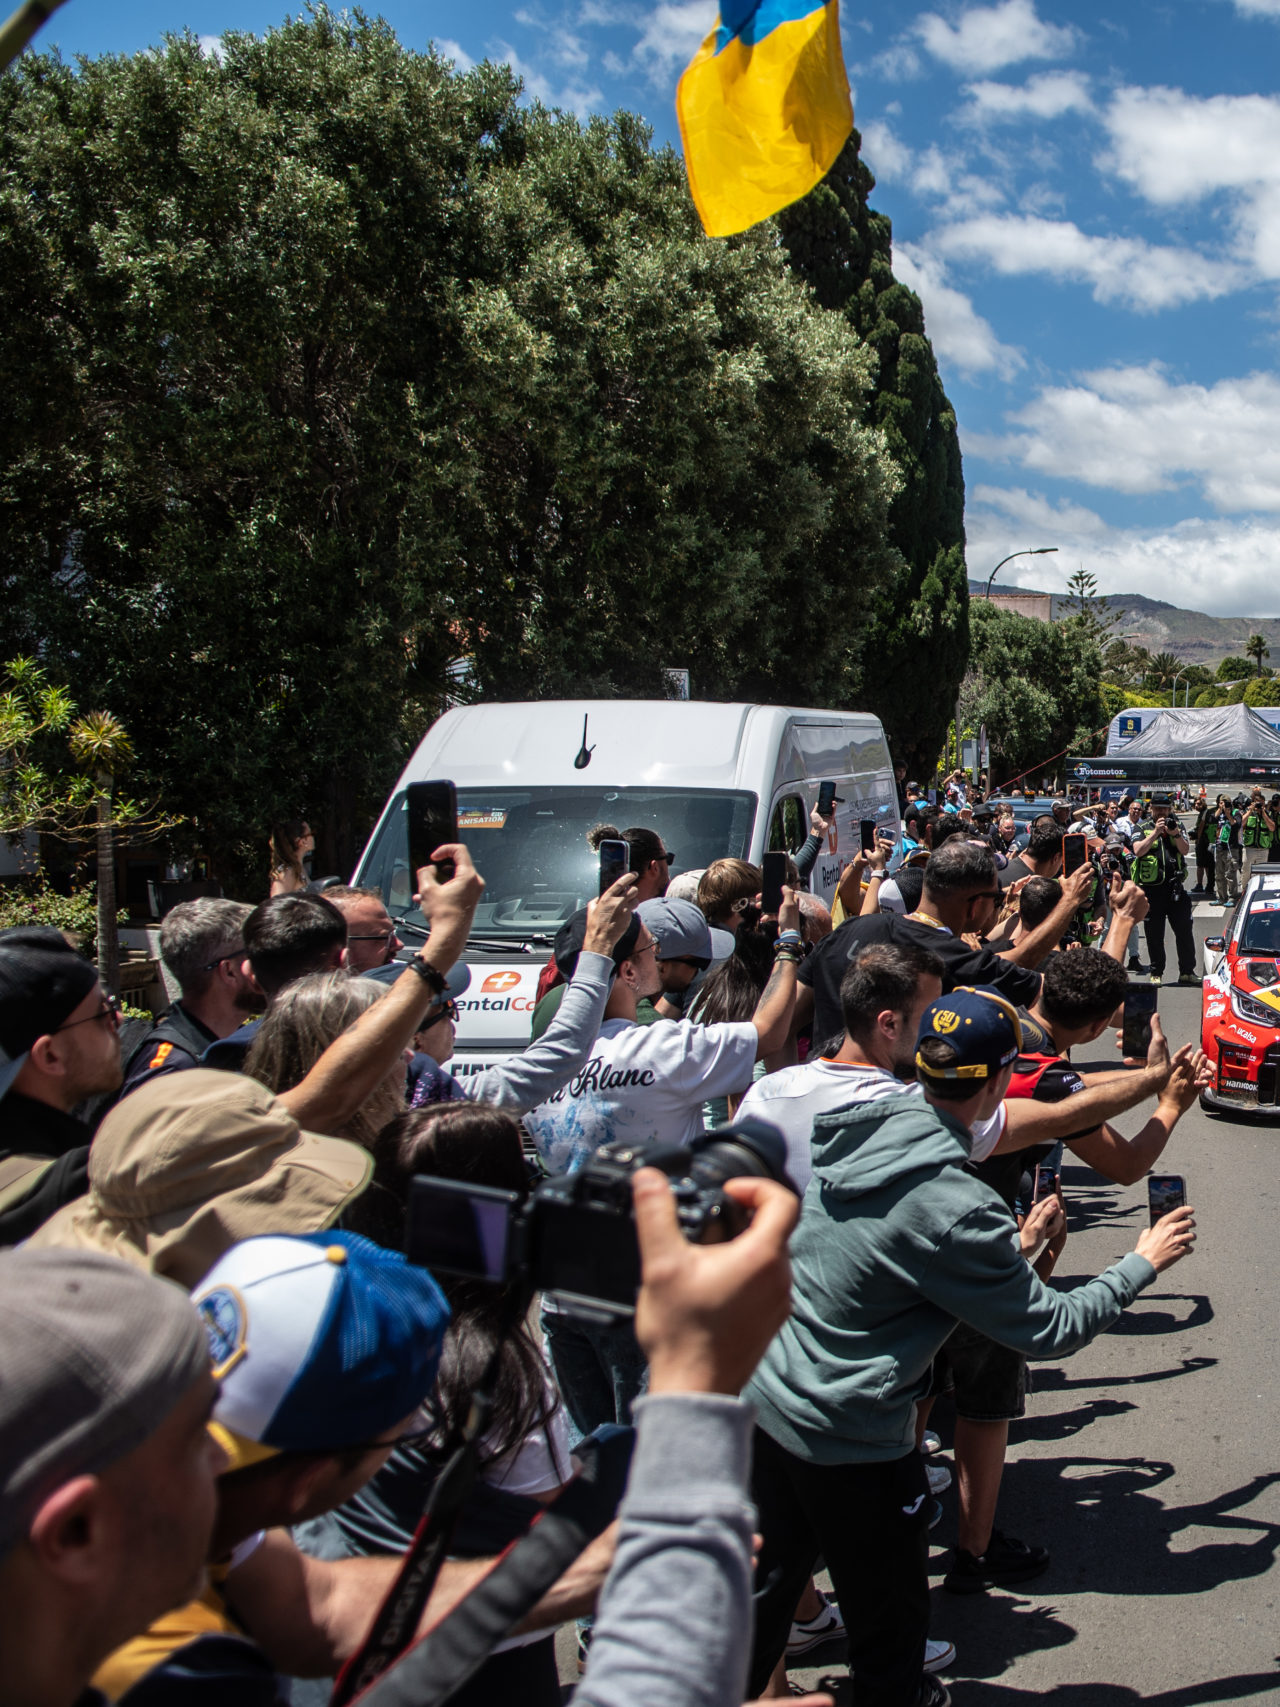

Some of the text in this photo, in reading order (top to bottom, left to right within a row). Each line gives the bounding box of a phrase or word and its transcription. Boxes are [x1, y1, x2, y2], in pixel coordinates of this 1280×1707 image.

[1079, 767, 1124, 775] Fotomotor
[458, 816, 504, 825] ANISATION
[456, 996, 536, 1011] entalCa
[940, 1010, 956, 1022] 50
[451, 1063, 499, 1077] FIA
[570, 1056, 656, 1097] Blanc
